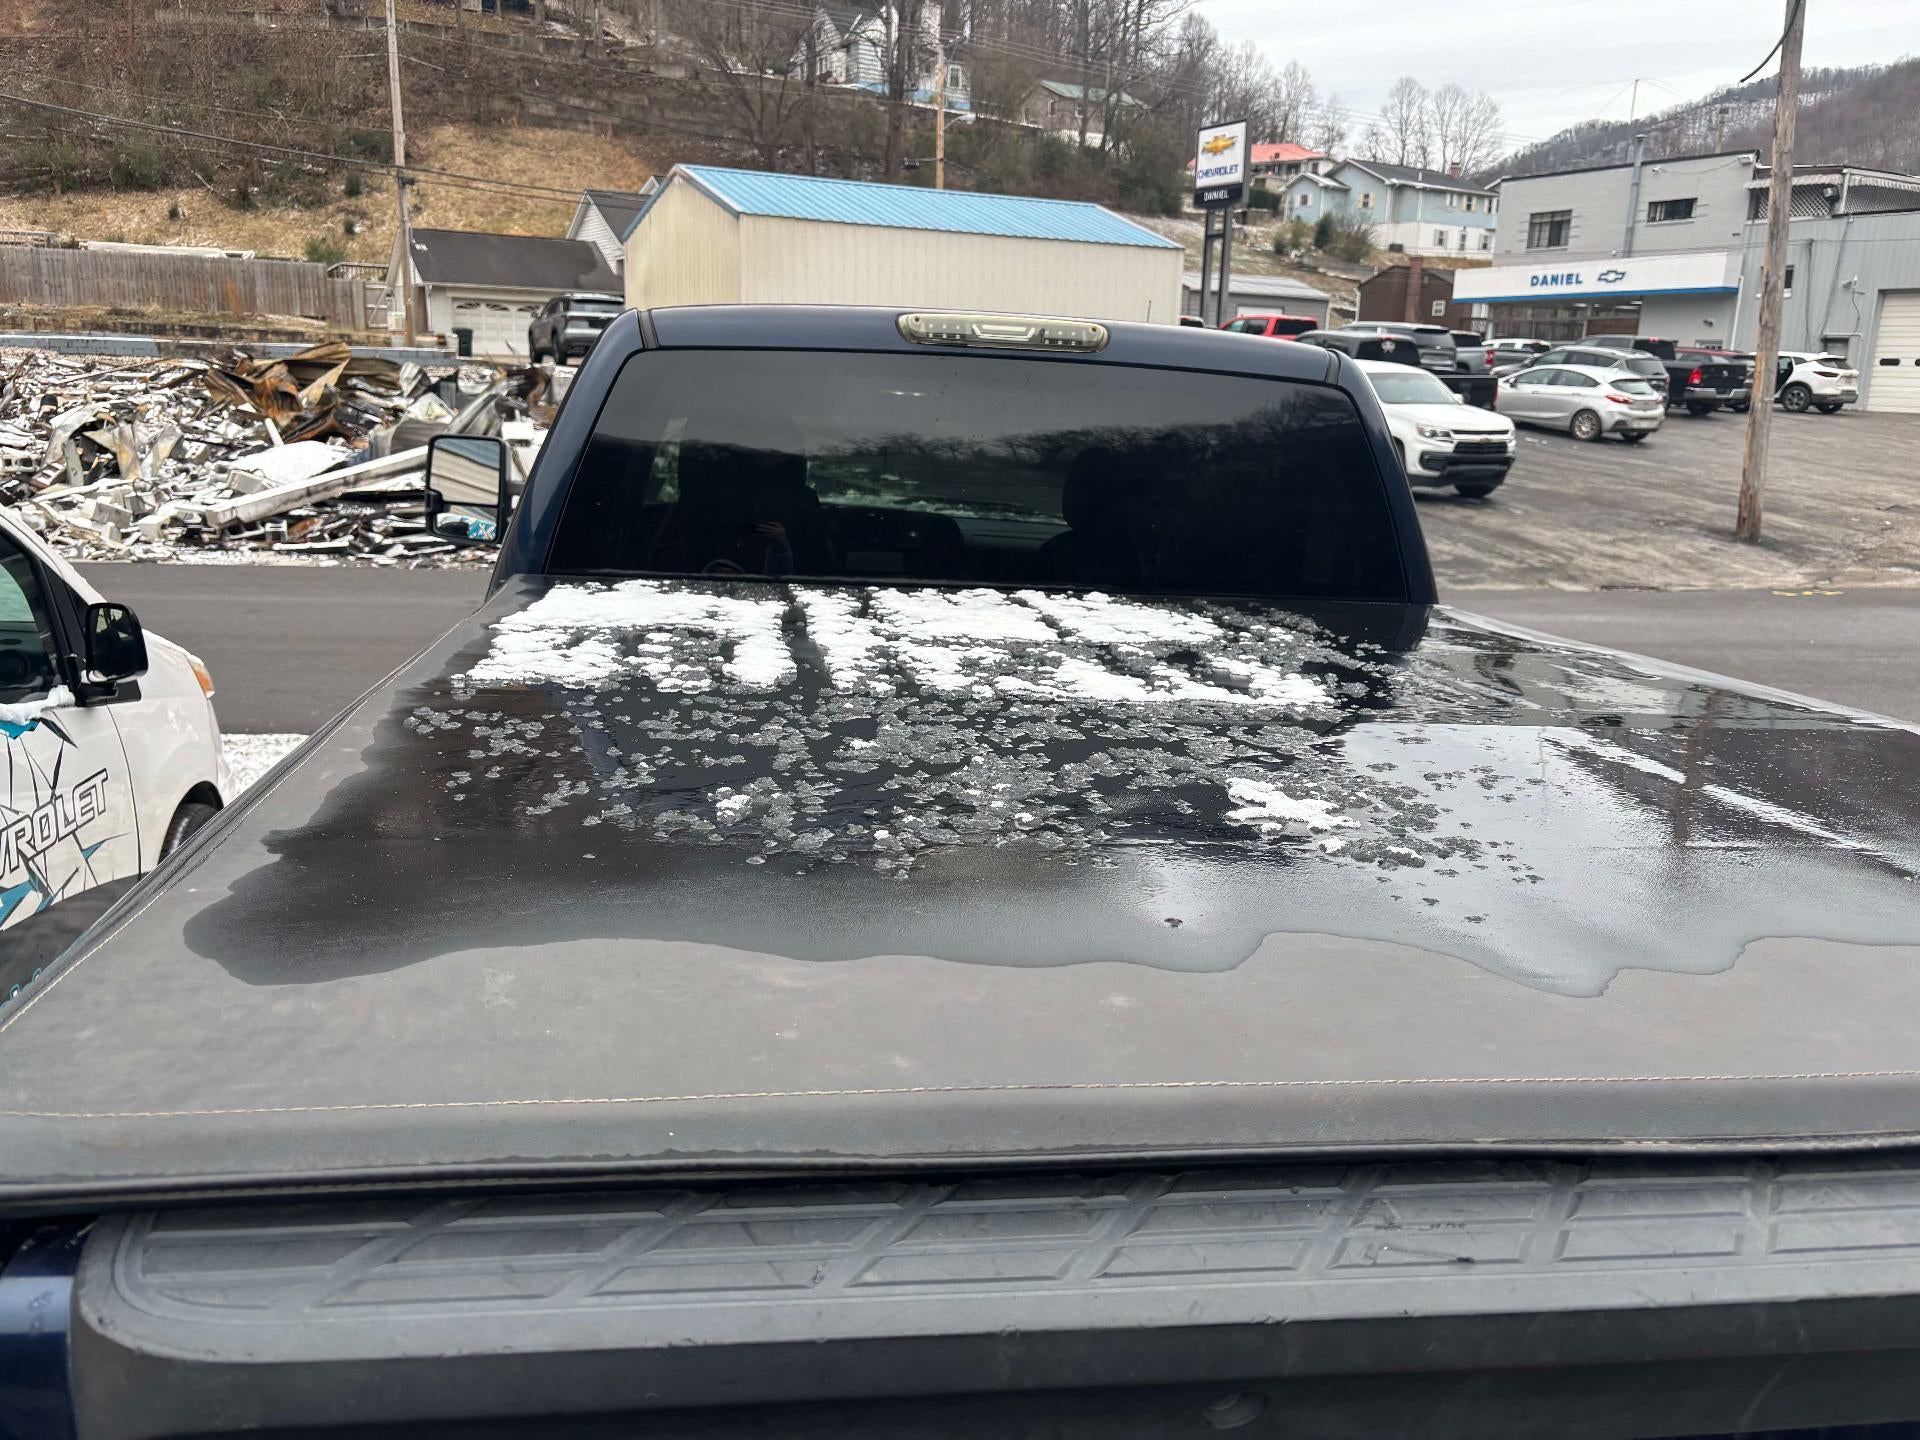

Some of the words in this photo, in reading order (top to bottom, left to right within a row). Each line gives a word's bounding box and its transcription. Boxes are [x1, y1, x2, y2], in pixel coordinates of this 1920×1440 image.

[1197, 164, 1238, 179] CHEVROLET
[1203, 190, 1229, 201] DANIEL
[1530, 273, 1583, 287] DANIEL
